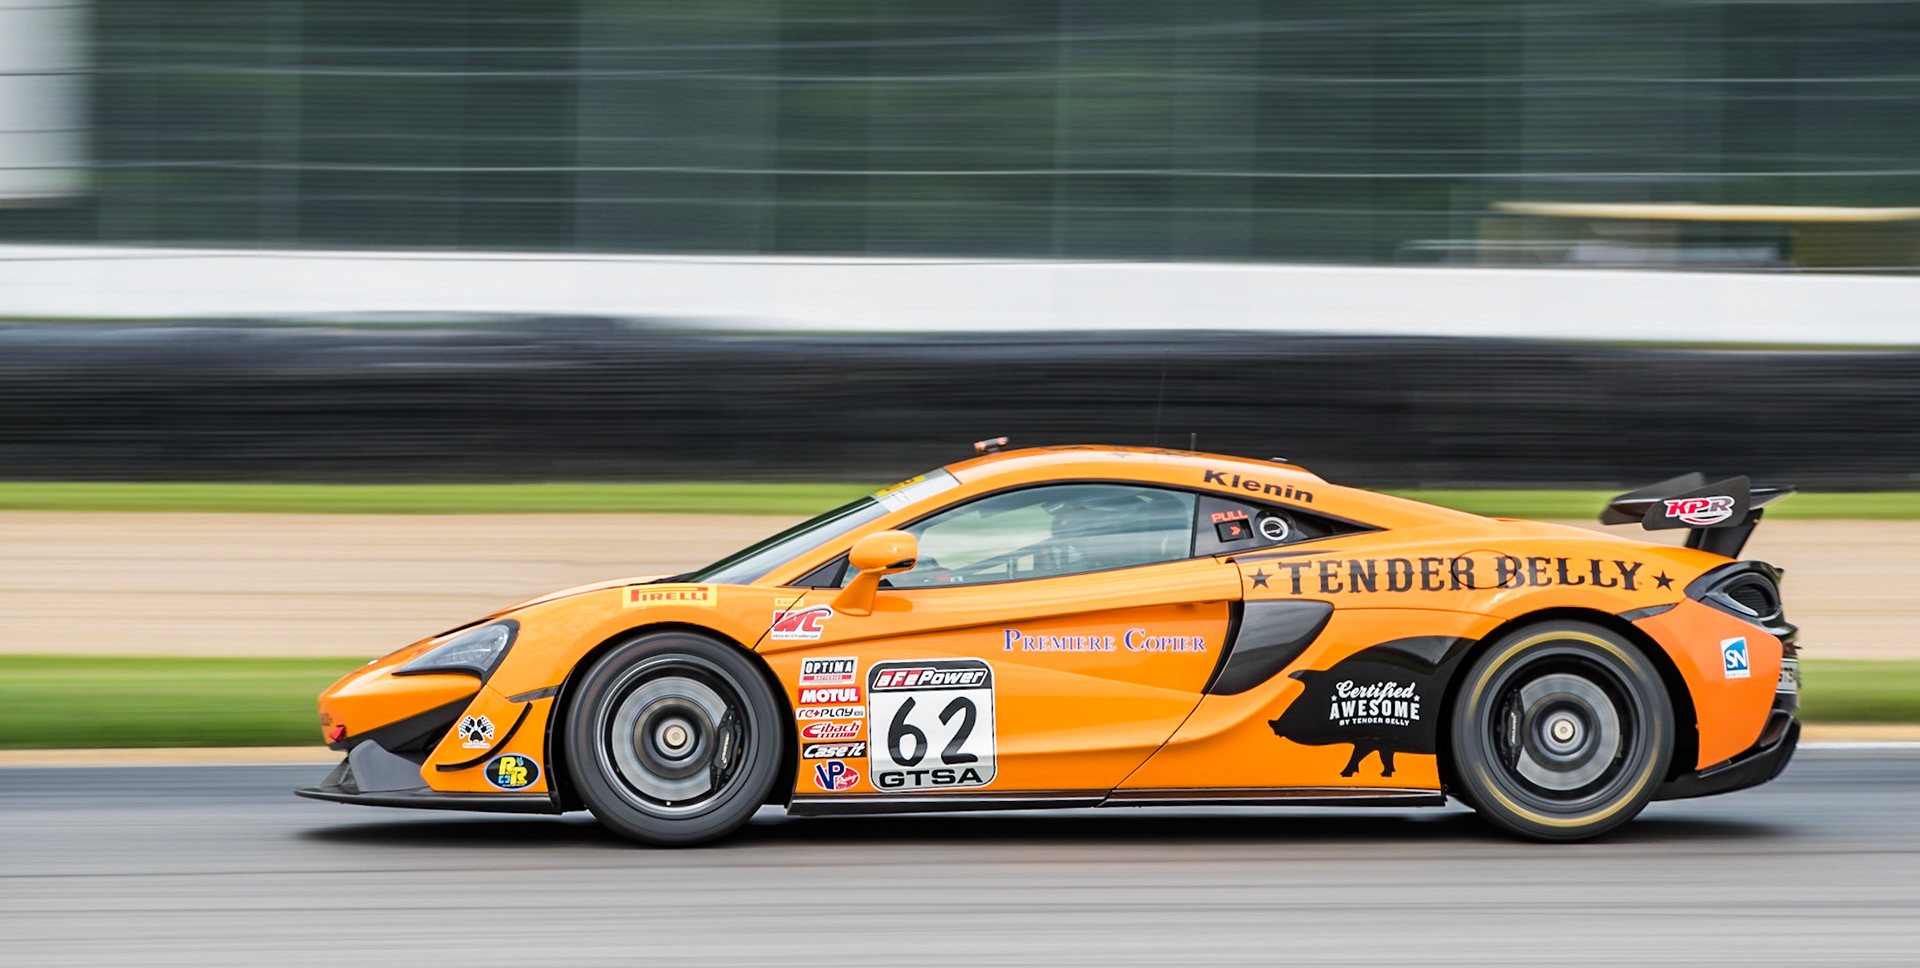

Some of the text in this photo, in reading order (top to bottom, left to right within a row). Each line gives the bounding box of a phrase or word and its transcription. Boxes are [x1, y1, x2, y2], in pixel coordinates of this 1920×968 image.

[1203, 469, 1314, 504] Klenin
[1211, 509, 1249, 523] PULL
[1666, 498, 1732, 515] KPR
[1278, 556, 1644, 595] TENDER BELLY
[630, 586, 709, 602] PIRELLI
[774, 608, 828, 633] WC
[1002, 628, 1207, 652] PREMIERE COPIER
[804, 660, 853, 674] OPTIMA
[1725, 649, 1748, 669] SN
[800, 688, 859, 703] MOTUL
[1335, 679, 1416, 704] Certified
[1329, 699, 1420, 721] AWESOME
[802, 721, 860, 739] Eibach
[887, 696, 979, 767] 62
[1339, 717, 1410, 727] BY TENDER BELLY
[816, 761, 845, 790] VP
[879, 768, 984, 788] GTSA
